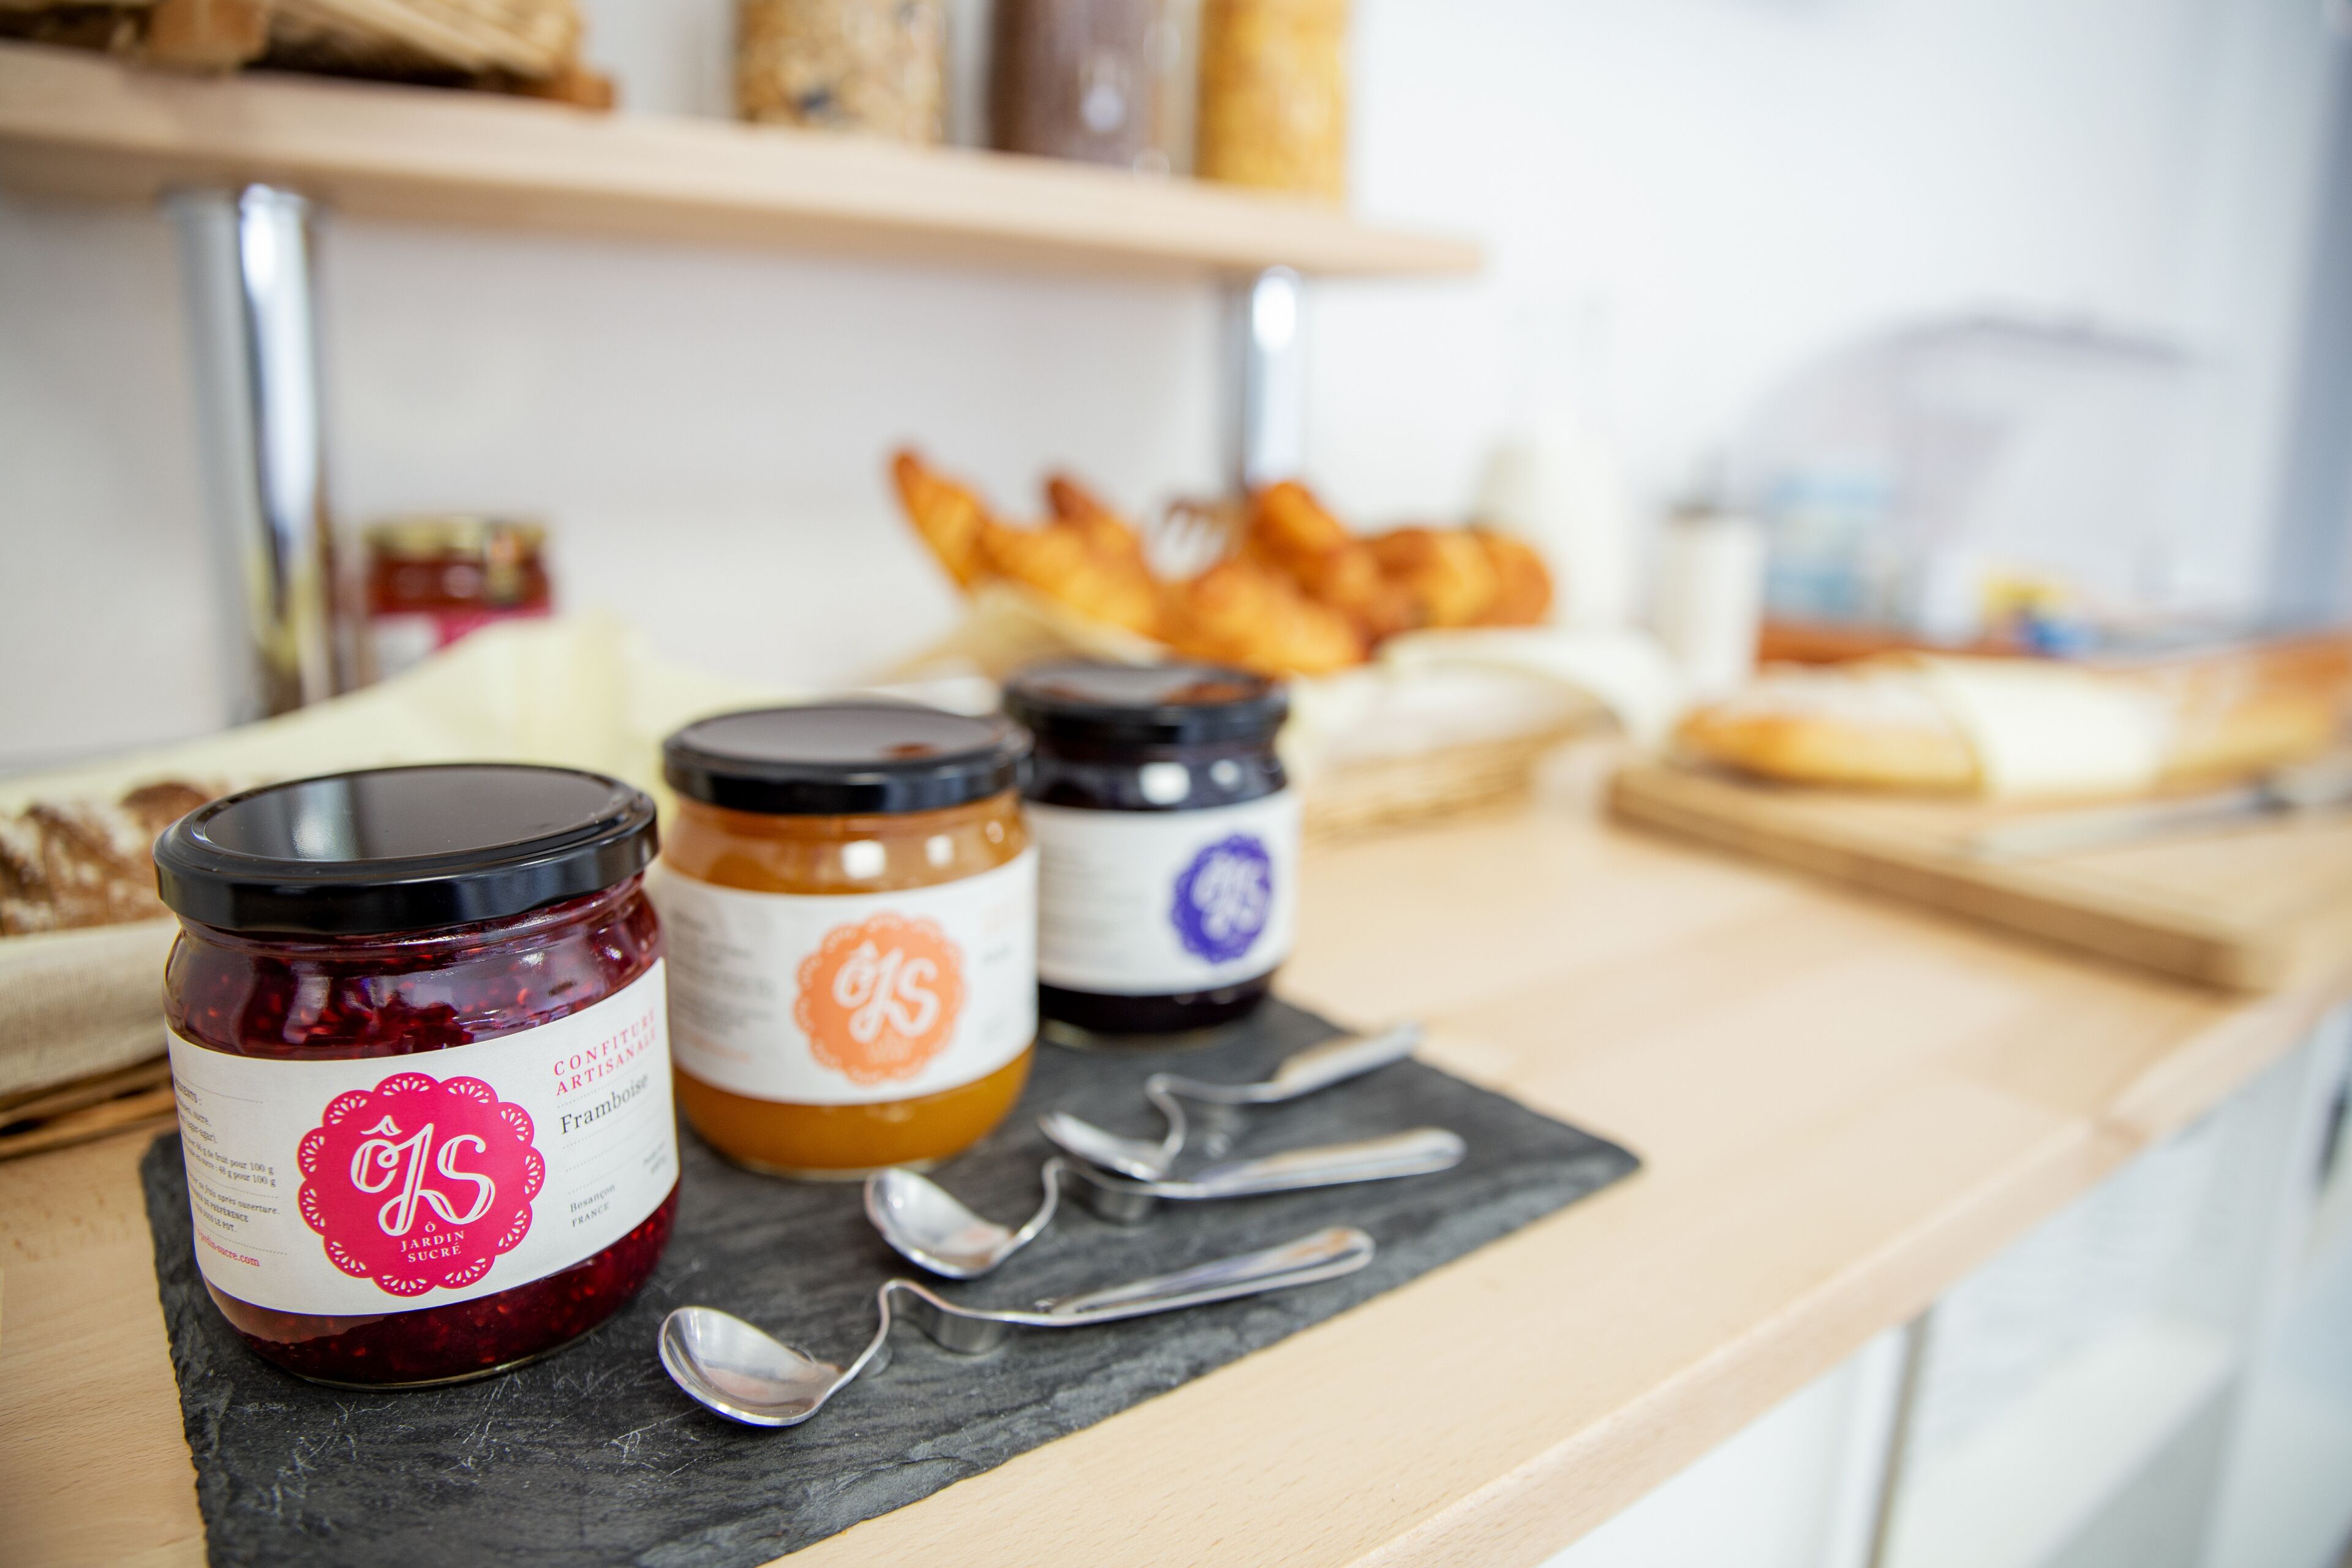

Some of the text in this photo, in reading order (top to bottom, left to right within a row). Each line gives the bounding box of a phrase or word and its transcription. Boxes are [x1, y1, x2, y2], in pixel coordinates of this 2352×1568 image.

[554, 1008, 655, 1076] CONFITURE
[557, 1027, 656, 1096] ARTISANALE
[560, 1074, 649, 1134] Framboise
[207, 1148, 214, 1158] de
[215, 1152, 228, 1164] fruit
[230, 1160, 247, 1169] pour
[250, 1162, 265, 1172] 100
[268, 1167, 274, 1175] g
[219, 1166, 226, 1175] 48
[227, 1170, 232, 1179] g
[233, 1172, 250, 1182] pour
[252, 1175, 268, 1185] 100
[270, 1179, 276, 1188] g
[217, 1194, 236, 1205] après
[238, 1201, 280, 1215] ouverture.
[570, 1184, 616, 1213] Besançon
[210, 1202, 249, 1223] PRÉFÉRENCE
[214, 1218, 221, 1227] LE
[571, 1202, 609, 1227] FRANCE
[401, 1230, 464, 1253] JARDIN
[407, 1242, 461, 1263] SUCRÉ
